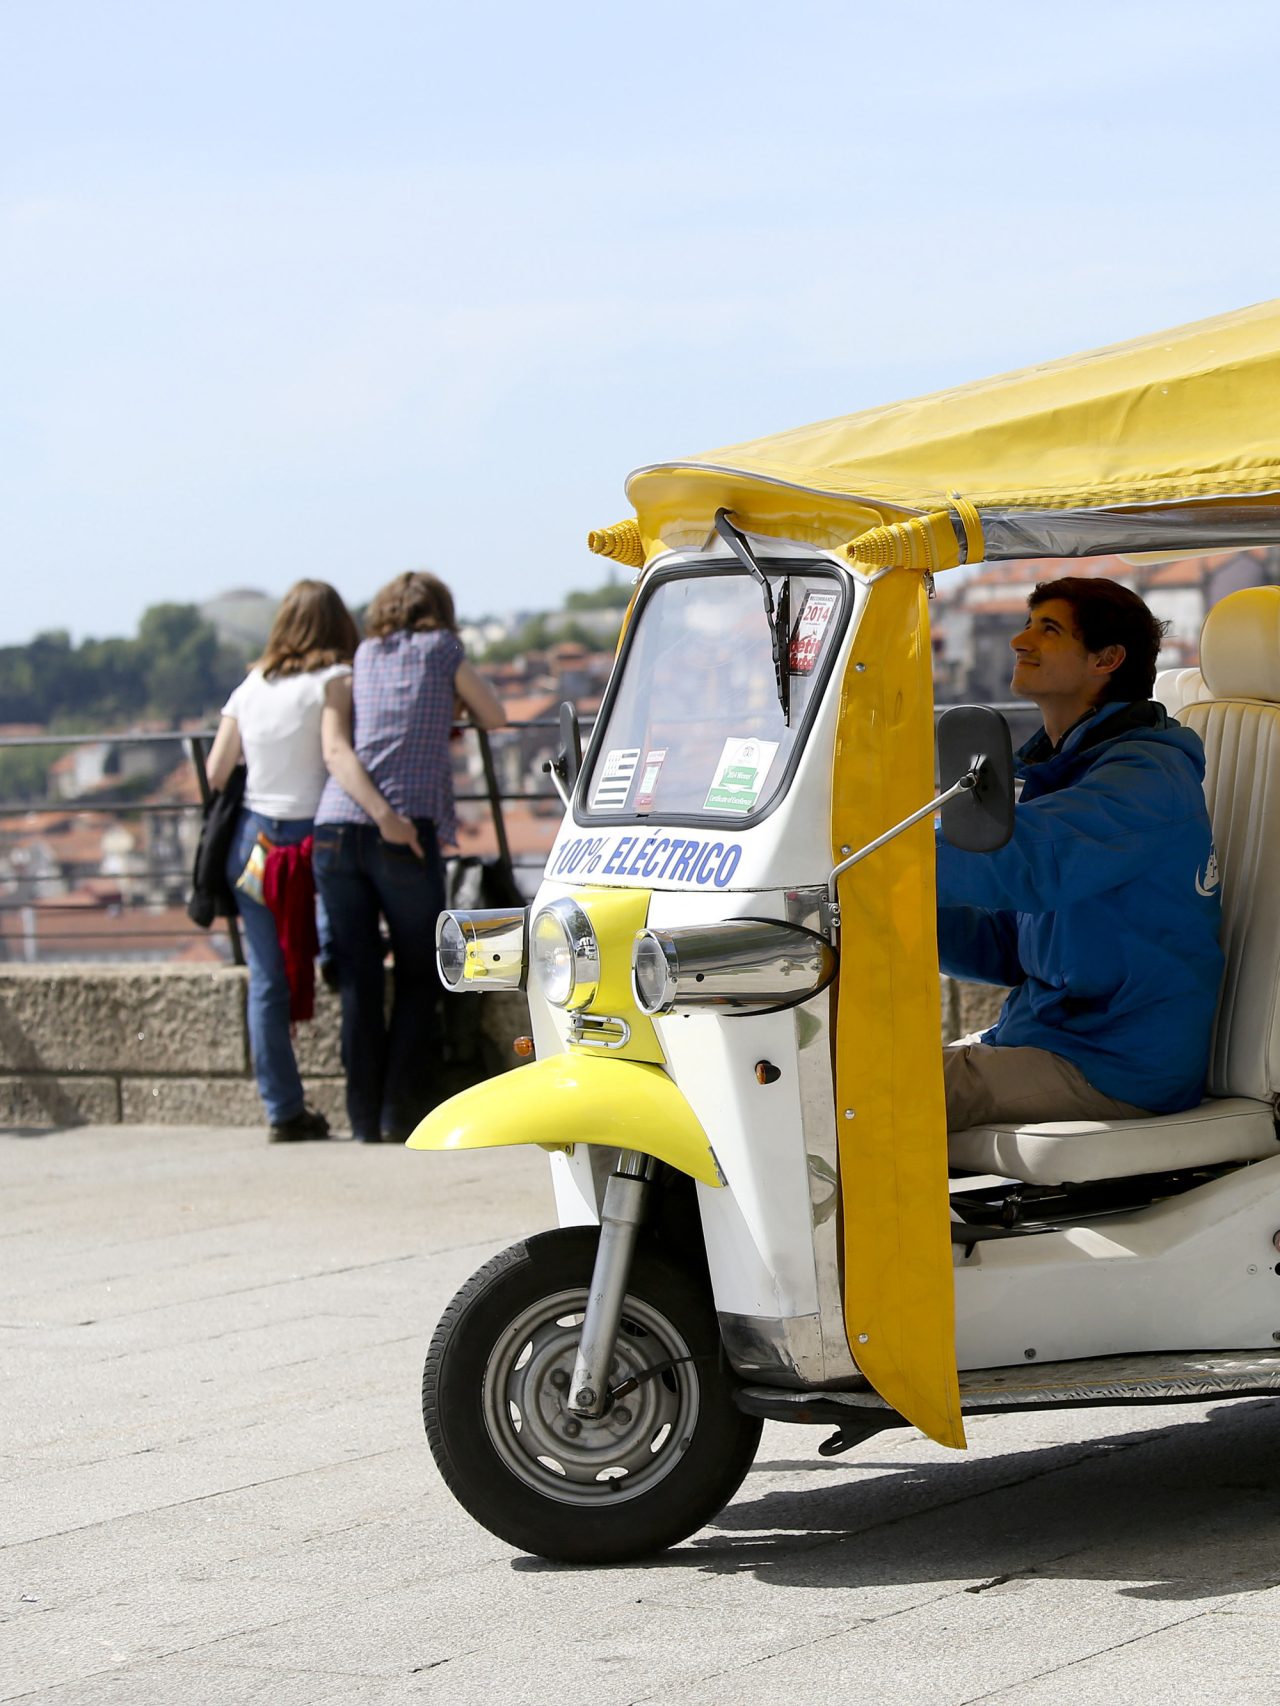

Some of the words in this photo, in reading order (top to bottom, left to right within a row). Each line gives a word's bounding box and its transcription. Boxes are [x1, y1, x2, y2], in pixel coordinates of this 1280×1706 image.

[804, 606, 830, 622] 2014
[550, 837, 610, 876] 100%
[602, 829, 742, 887] ELÉCTRICO
